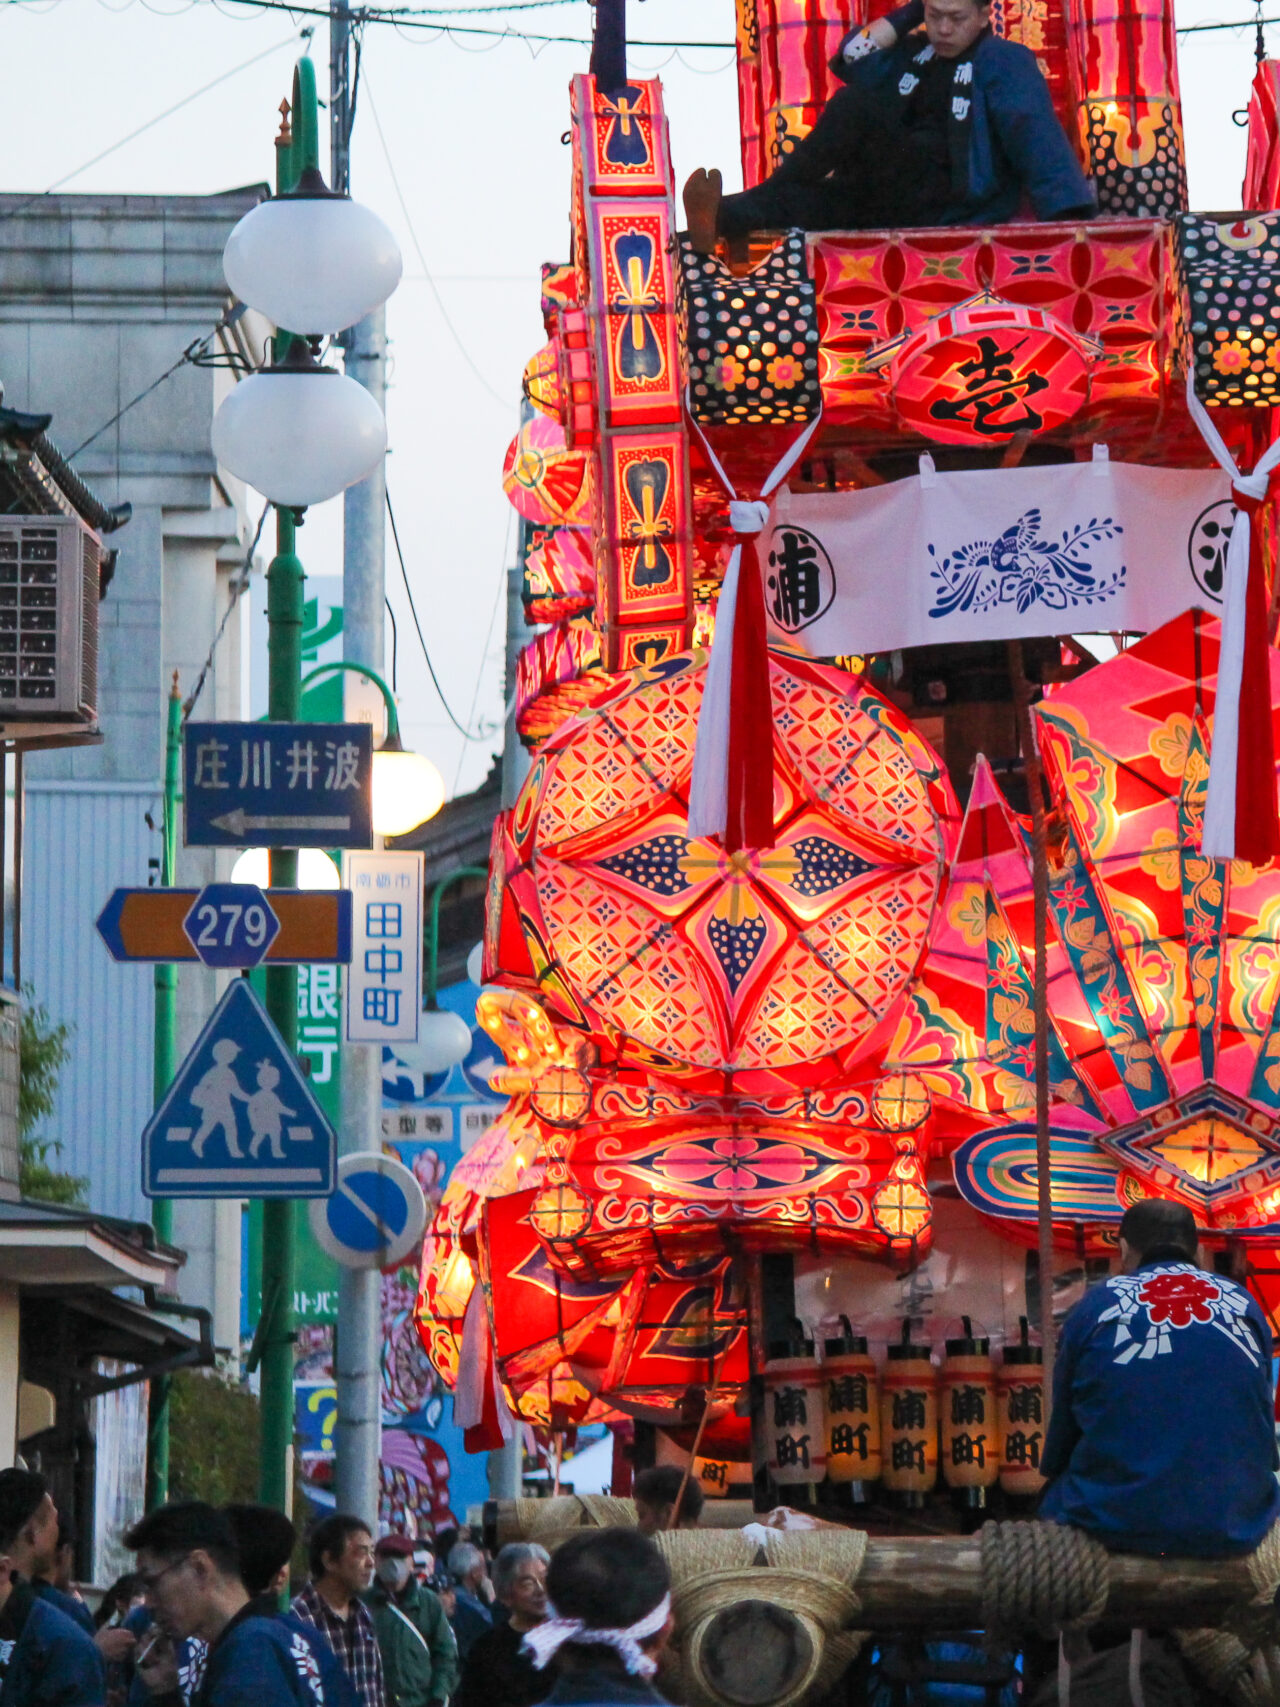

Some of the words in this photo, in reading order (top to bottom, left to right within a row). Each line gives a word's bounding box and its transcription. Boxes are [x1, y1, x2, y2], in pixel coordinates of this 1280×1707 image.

[767, 532, 821, 628] 浦
[194, 737, 362, 791] 庄川・井波
[197, 904, 268, 947] 279
[362, 902, 403, 1027] 田中町
[774, 1386, 811, 1470] 浦町
[828, 1372, 871, 1461] 浦町
[891, 1388, 928, 1475] 浦町
[950, 1383, 987, 1470] 浦町
[1005, 1383, 1043, 1470] 浦町
